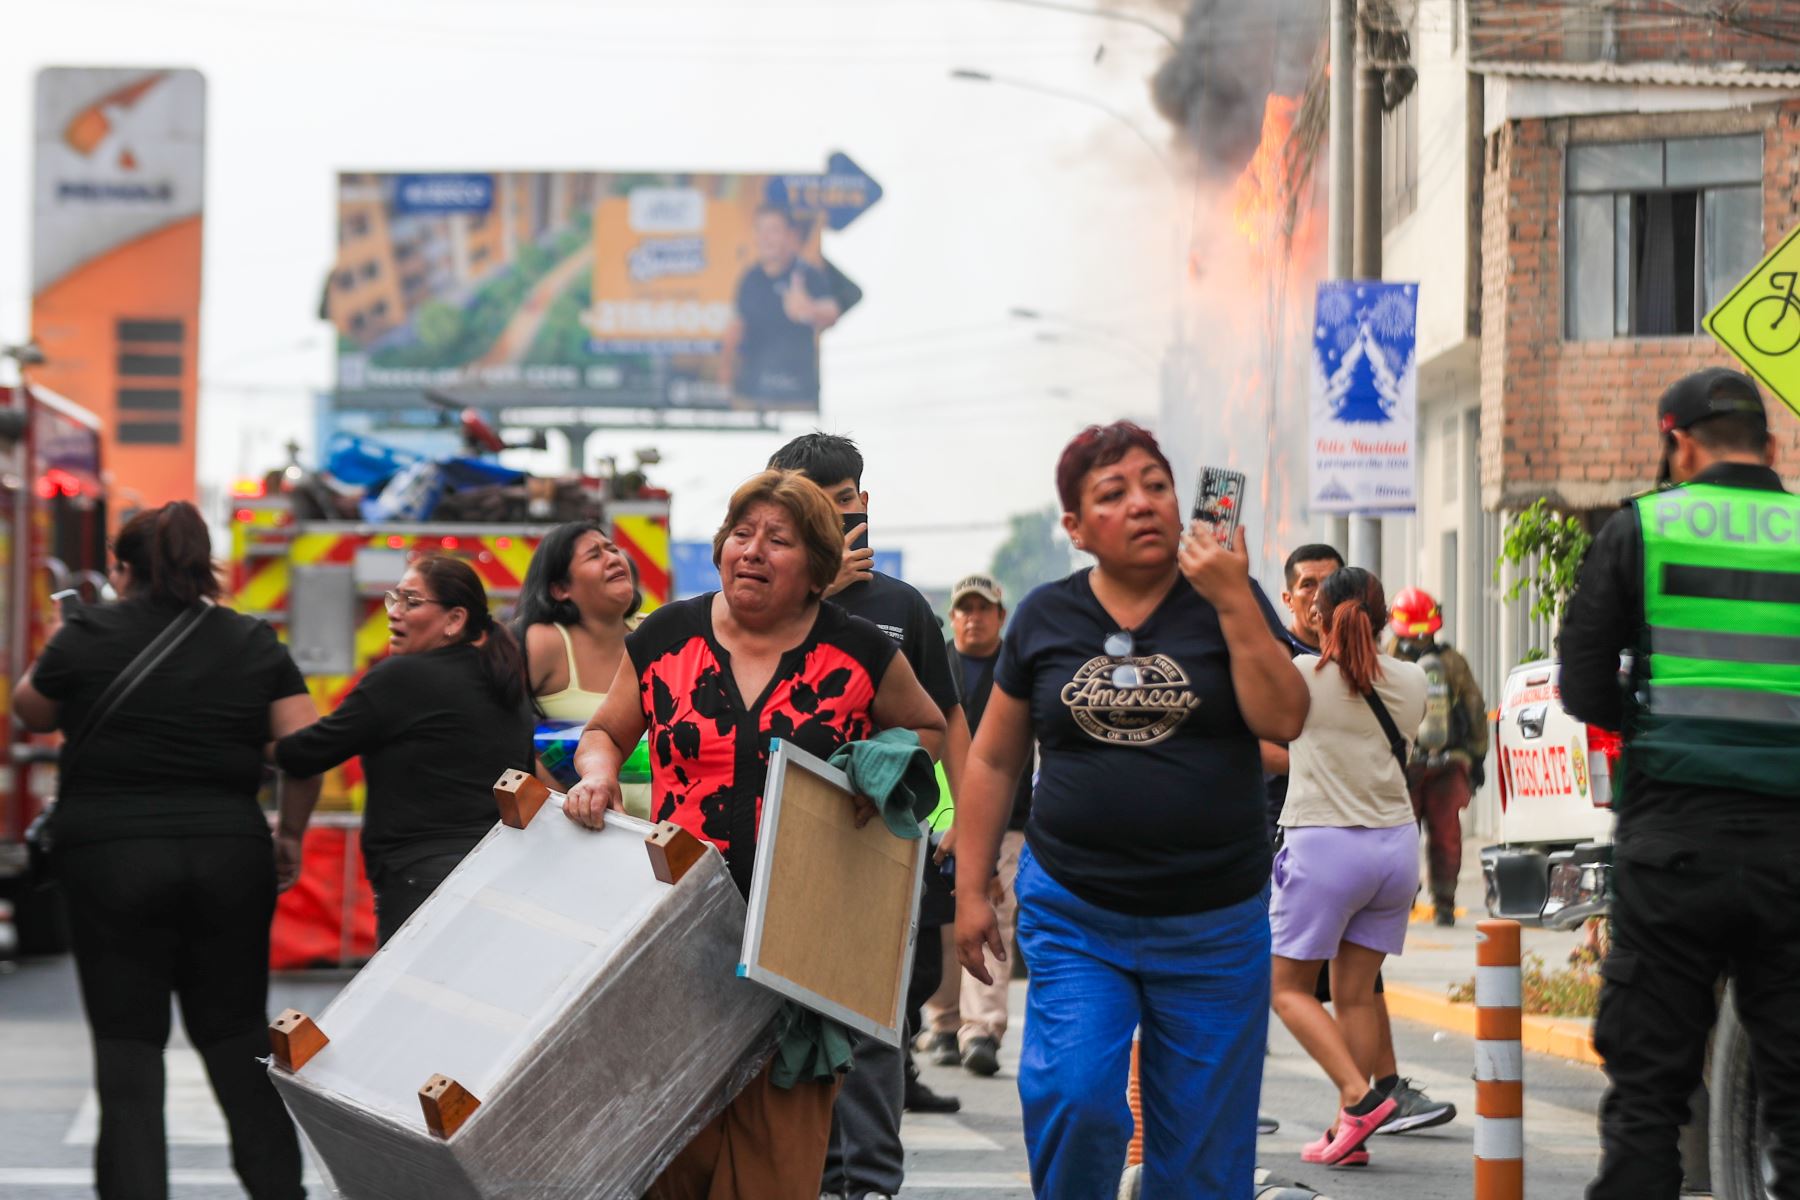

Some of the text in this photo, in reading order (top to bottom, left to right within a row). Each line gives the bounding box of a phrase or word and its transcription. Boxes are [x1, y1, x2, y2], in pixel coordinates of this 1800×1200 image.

[1315, 438, 1408, 455] Feliz Navidad
[1083, 658, 1109, 676] LAND
[1154, 658, 1178, 680] FREE
[1061, 678, 1201, 710] American
[1076, 710, 1105, 736] HOME
[1107, 731, 1121, 741] OF
[1128, 732, 1149, 741] THE
[1512, 746, 1572, 798] RESCATE
